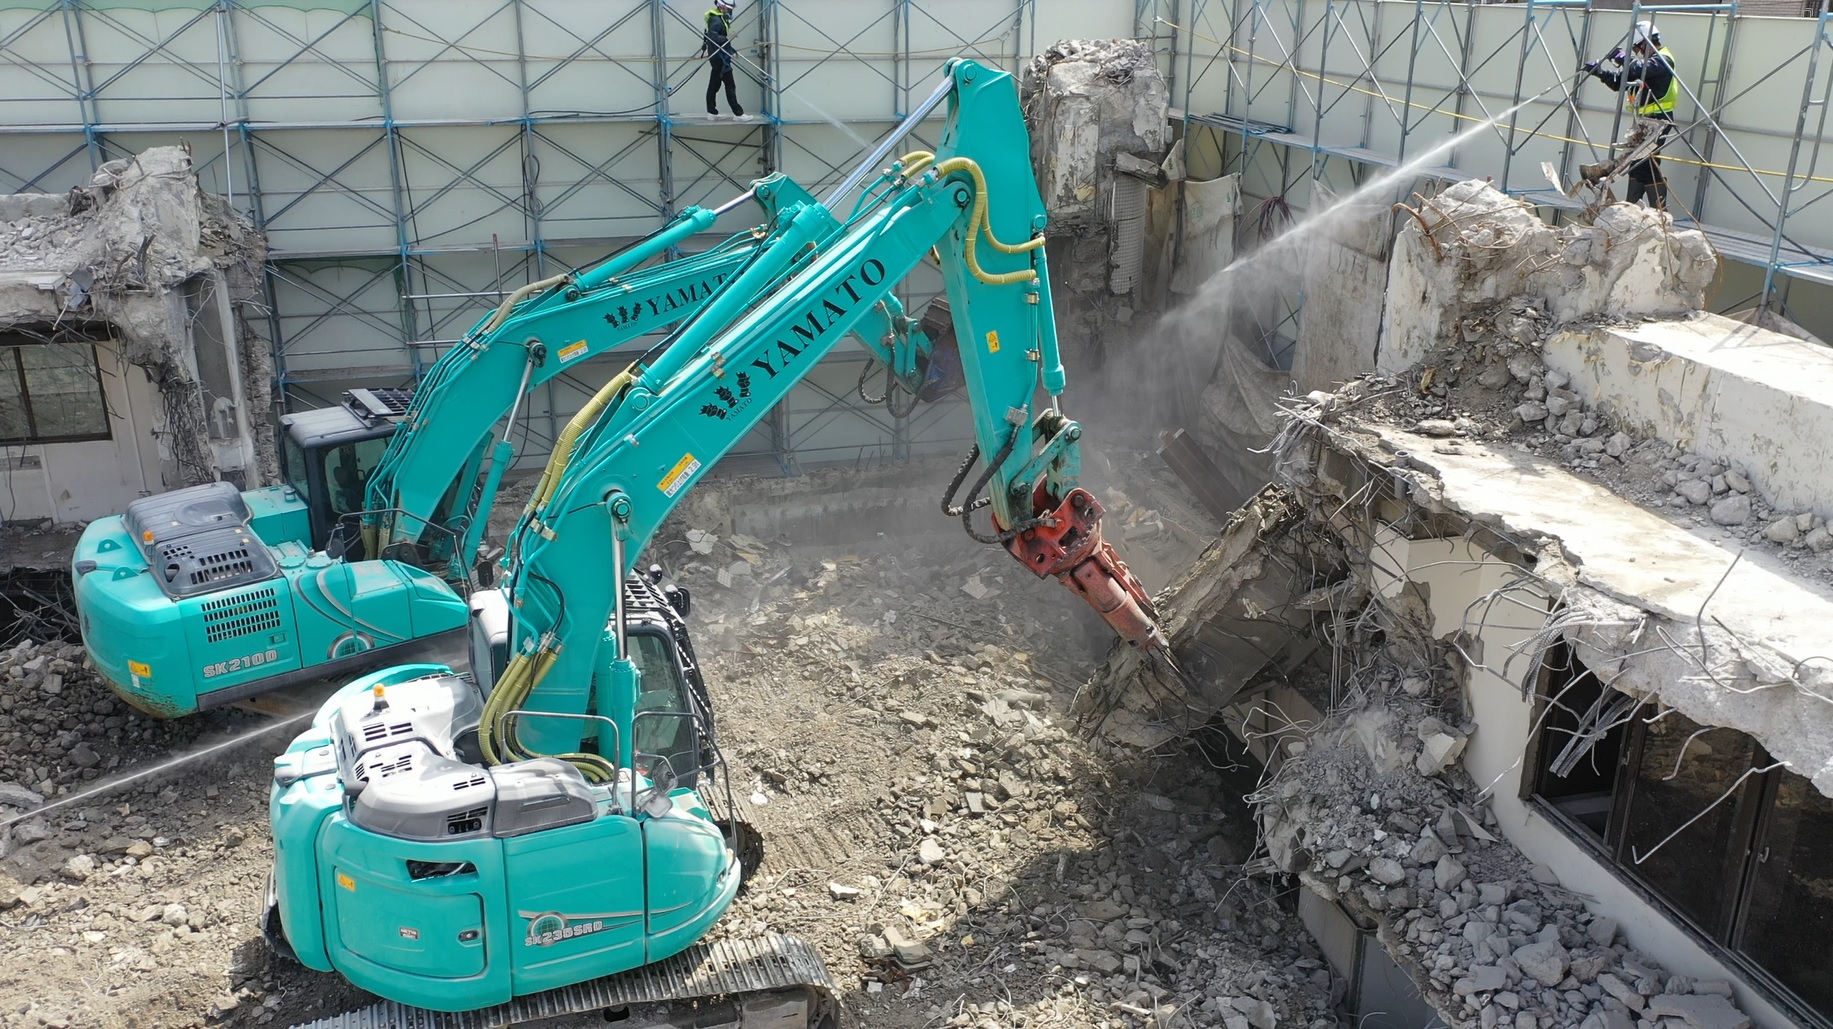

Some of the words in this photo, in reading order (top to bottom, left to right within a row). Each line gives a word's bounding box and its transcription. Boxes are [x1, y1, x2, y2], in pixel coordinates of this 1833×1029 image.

[645, 268, 737, 317] YAMAT
[750, 258, 886, 380] YAMATO
[726, 397, 753, 422] YAMATO
[203, 649, 279, 678] SK210D
[524, 920, 604, 946] SK235SRD
